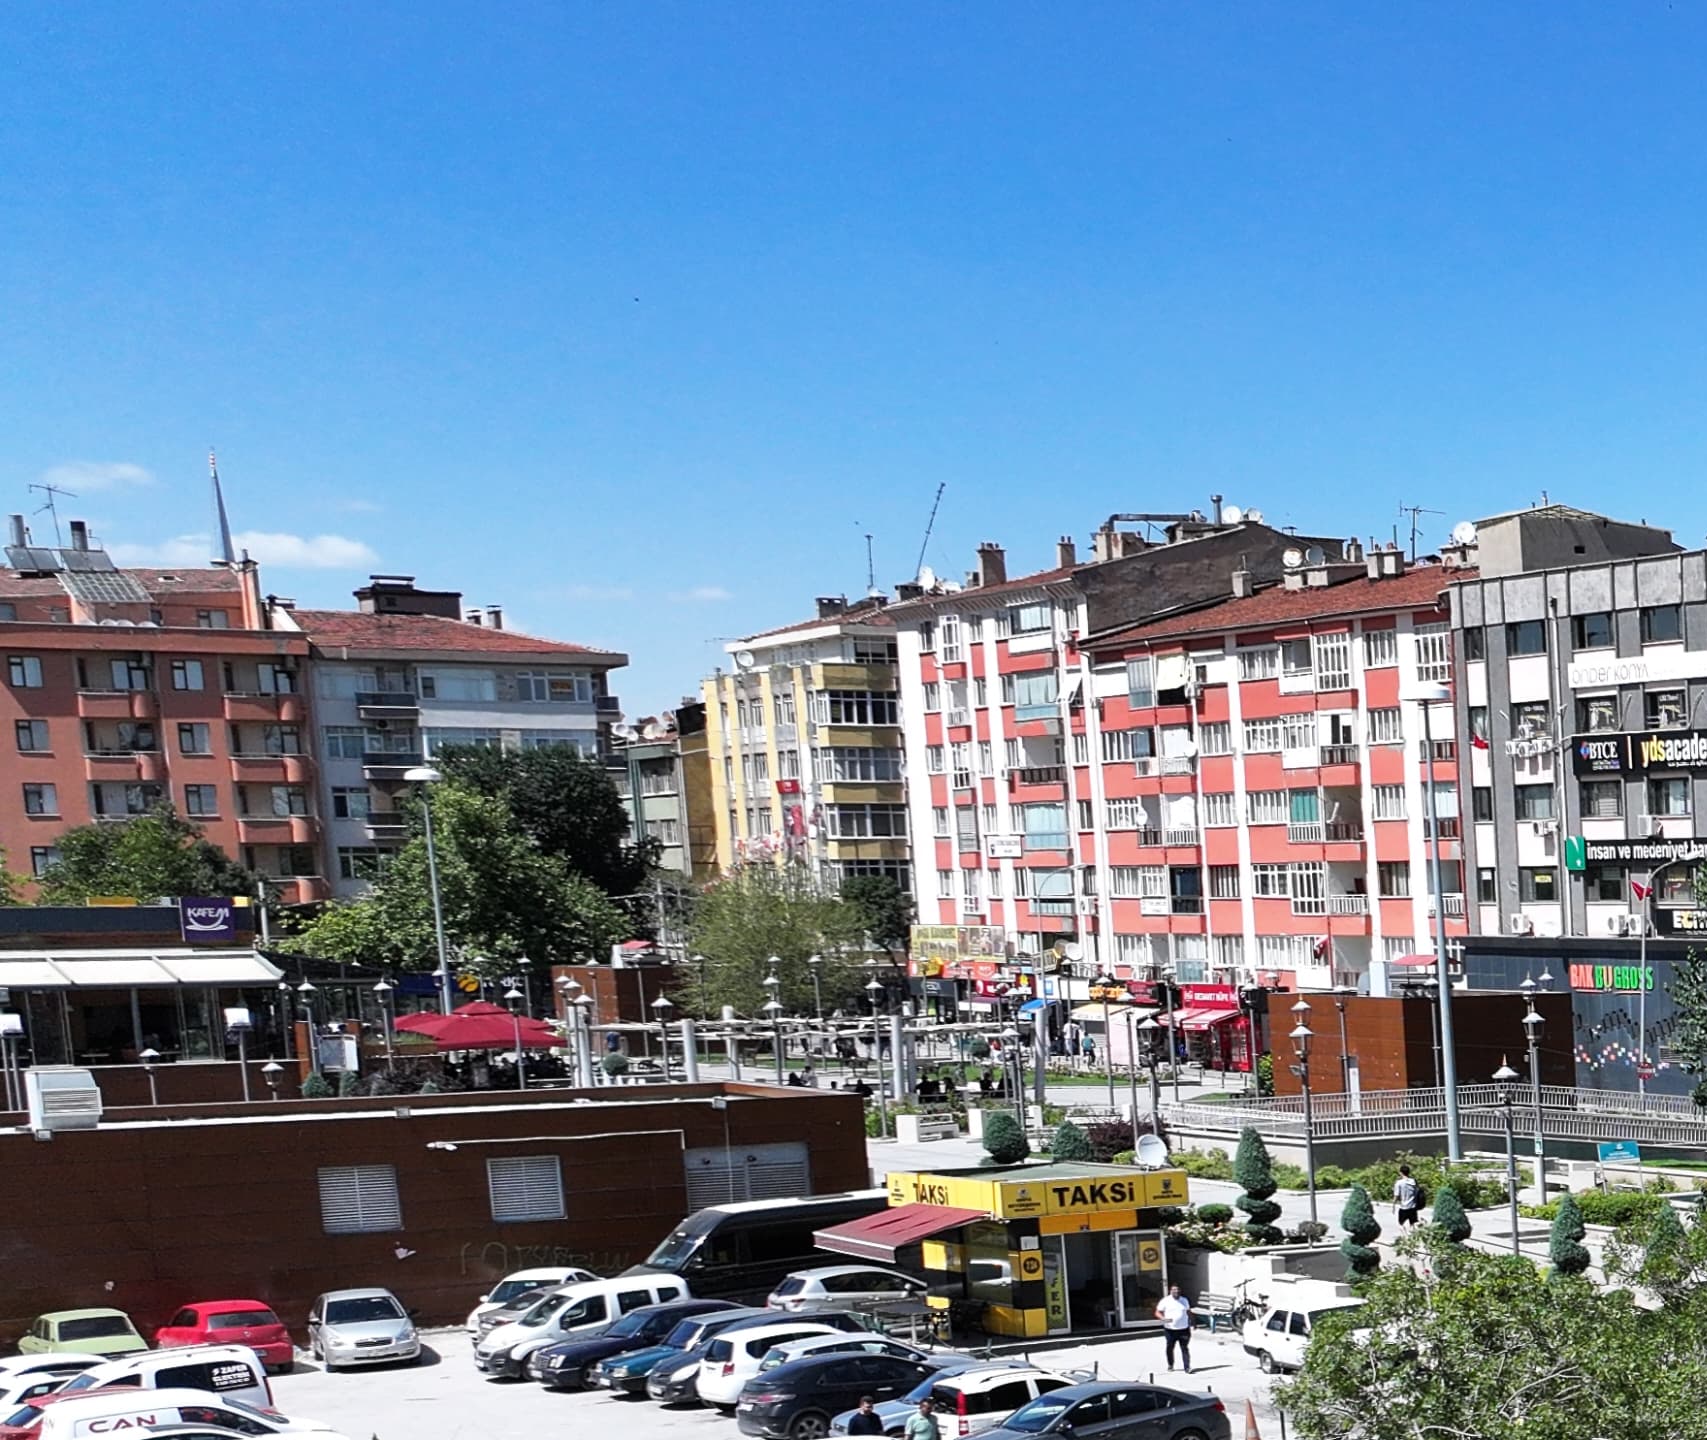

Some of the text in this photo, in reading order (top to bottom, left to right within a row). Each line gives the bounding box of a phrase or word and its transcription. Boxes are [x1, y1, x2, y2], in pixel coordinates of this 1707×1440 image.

[1589, 741, 1618, 759] BTCE
[1587, 842, 1616, 860] insan
[1618, 846, 1631, 859] ve
[1633, 840, 1689, 862] medeniyet
[88, 1415, 156, 1433] CAN
